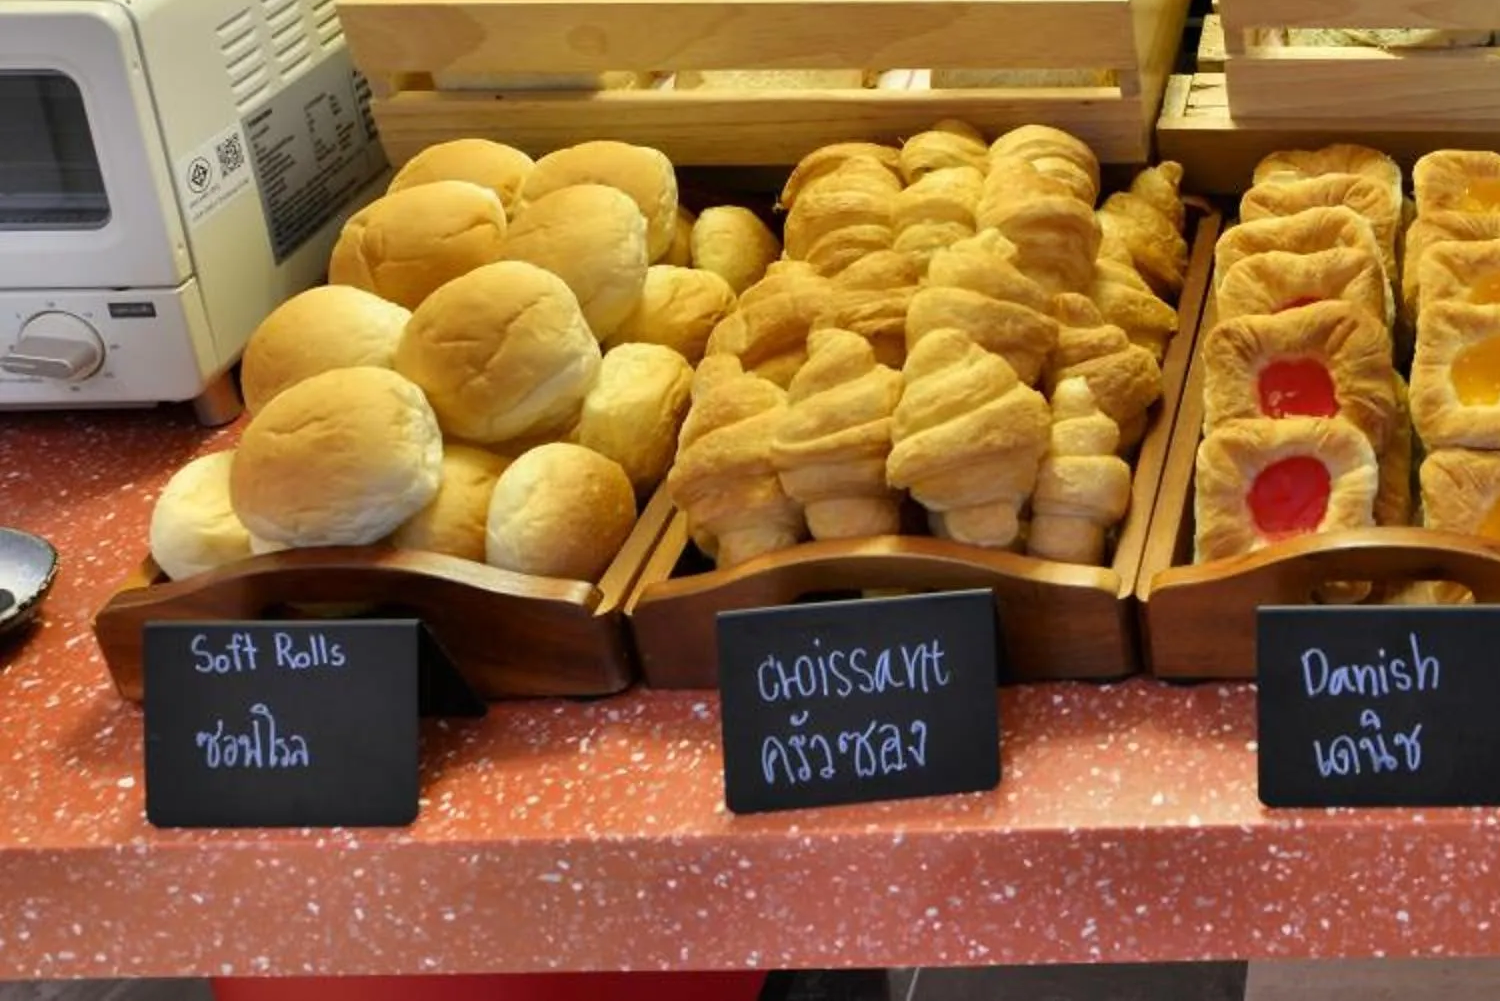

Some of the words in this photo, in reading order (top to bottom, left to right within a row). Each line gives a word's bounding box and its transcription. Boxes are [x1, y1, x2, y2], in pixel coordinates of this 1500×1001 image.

[191, 632, 258, 674] Soft
[273, 632, 346, 670] Rolls
[1301, 632, 1440, 697] Danish
